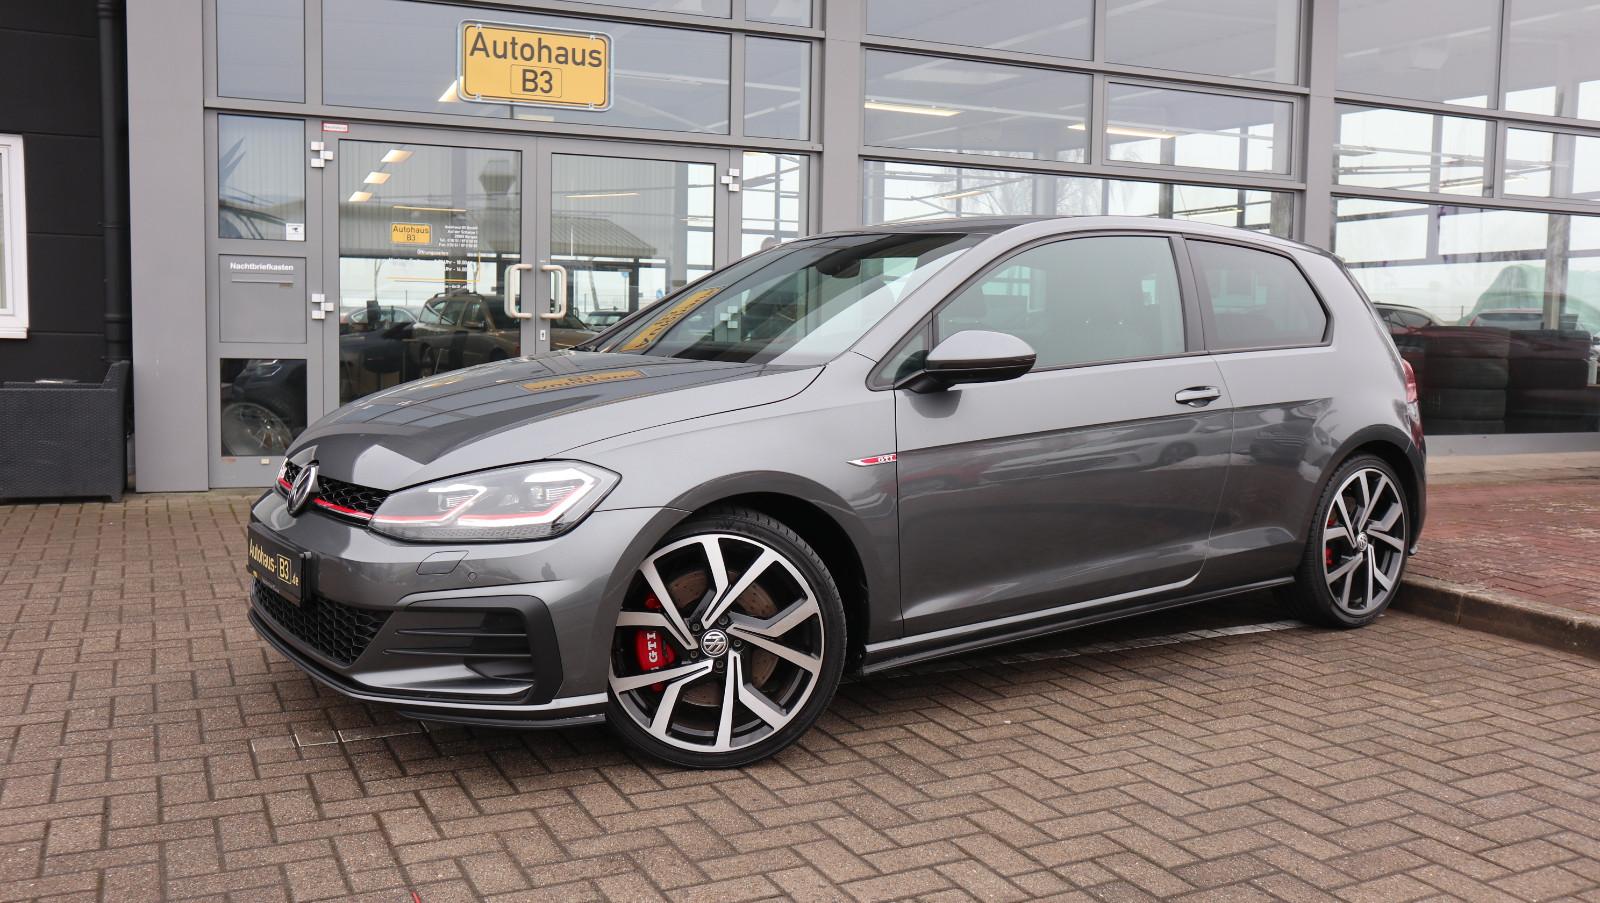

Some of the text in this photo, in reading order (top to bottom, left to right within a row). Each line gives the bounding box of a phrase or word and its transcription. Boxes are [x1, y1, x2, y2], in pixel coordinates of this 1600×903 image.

[469, 31, 602, 68] Autohaus
[521, 68, 553, 94] B3
[392, 225, 429, 234] Autohaus
[230, 262, 294, 271] Nachtbriefkasten
[279, 557, 290, 580] B3
[646, 632, 659, 663] GTI
